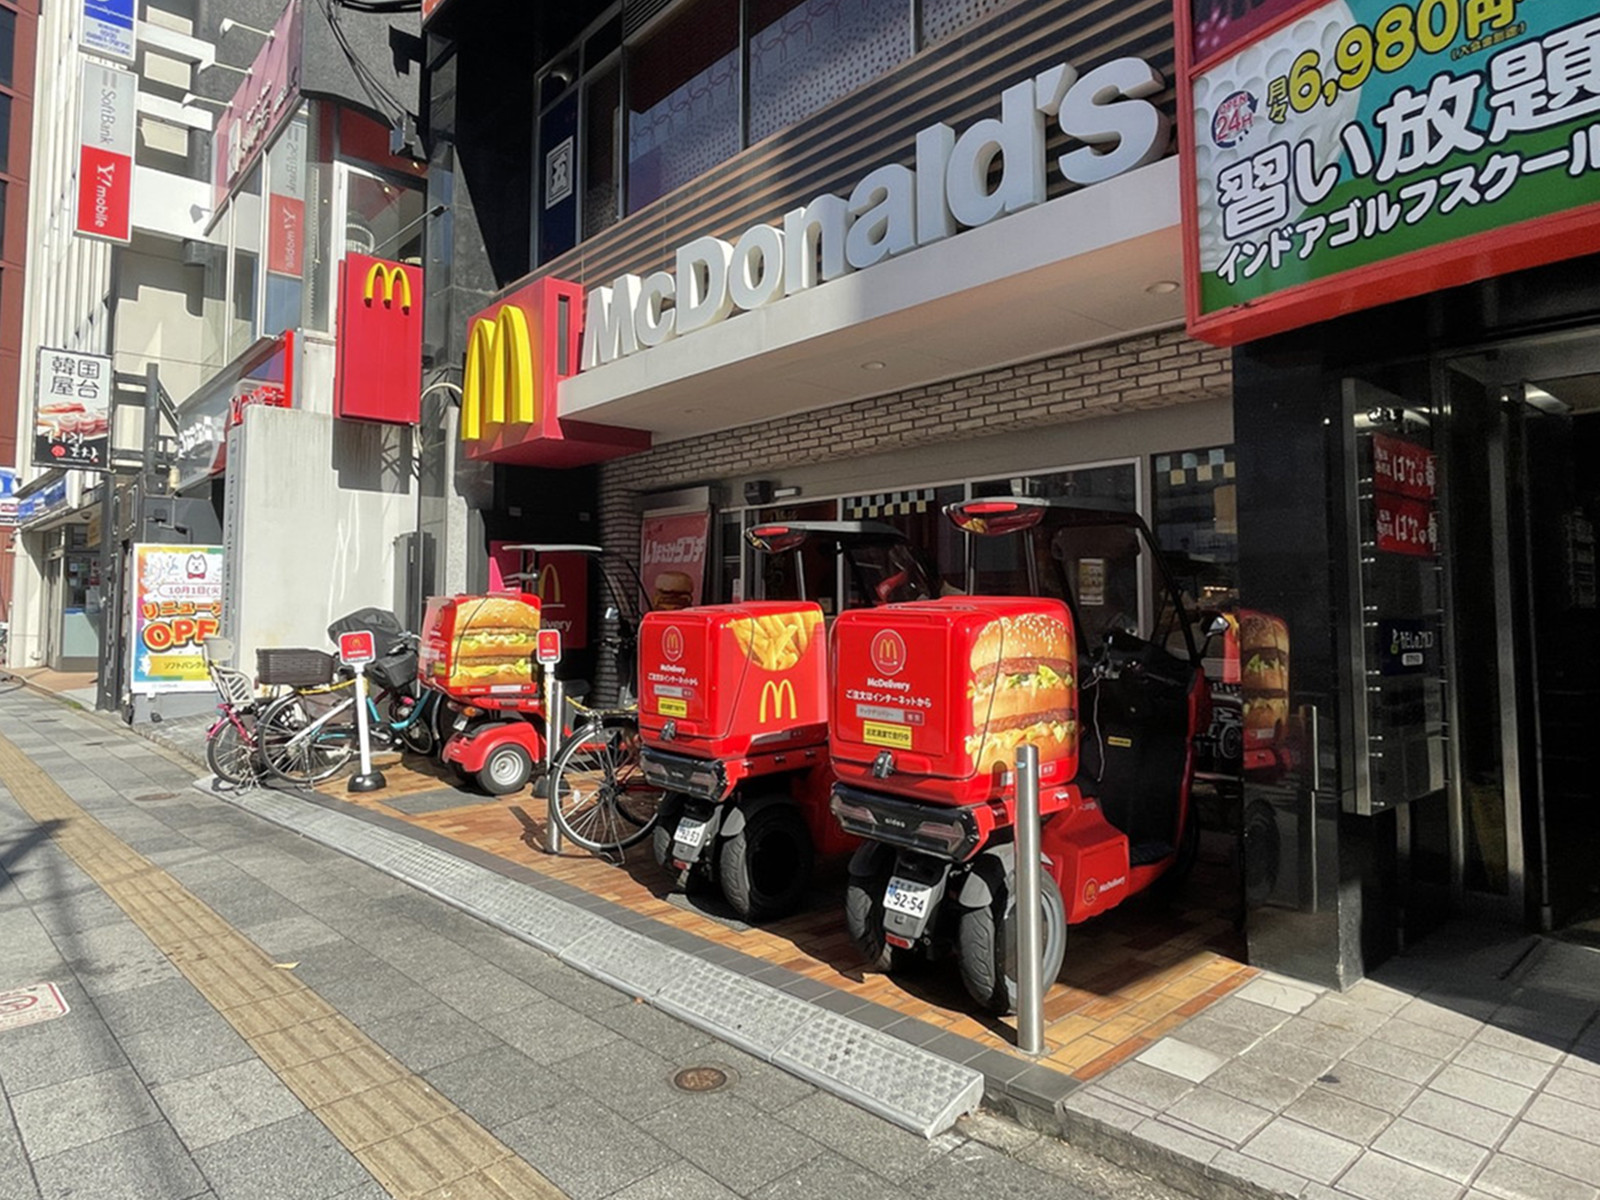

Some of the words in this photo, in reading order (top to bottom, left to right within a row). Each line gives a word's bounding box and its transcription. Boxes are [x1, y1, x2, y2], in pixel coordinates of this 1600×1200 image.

[100, 88, 118, 144] SoftBank
[1216, 108, 1254, 141] 24H
[1217, 14, 1600, 239] 習い放題
[94, 162, 115, 227] Y!mobile
[581, 56, 1167, 371] McDonald's
[1216, 123, 1600, 284] インドアゴルフスクール
[50, 376, 100, 400] 屋台
[51, 355, 100, 380] 韓国
[143, 618, 220, 653] OPE
[163, 661, 210, 672] ソフトバンク
